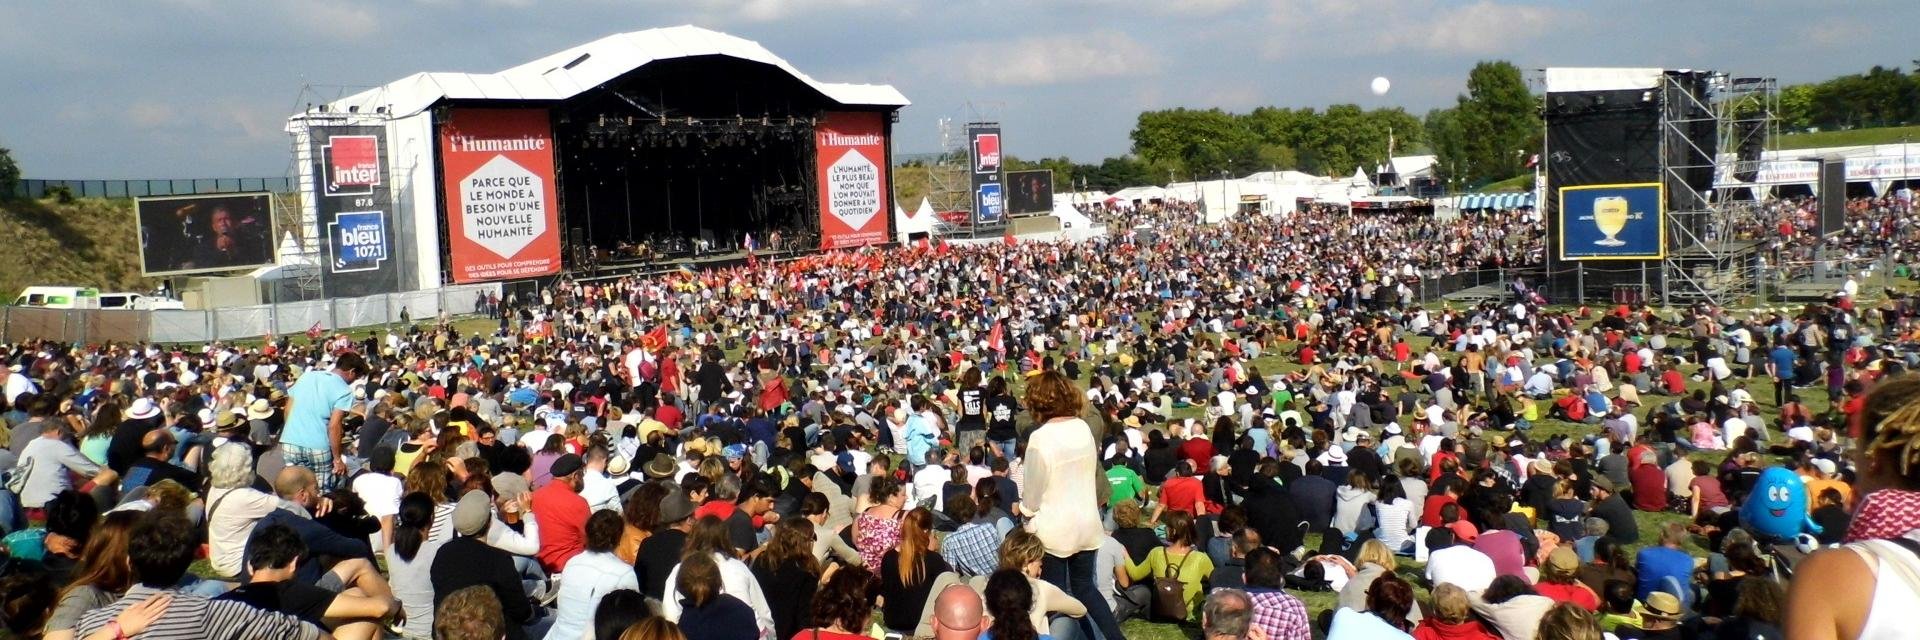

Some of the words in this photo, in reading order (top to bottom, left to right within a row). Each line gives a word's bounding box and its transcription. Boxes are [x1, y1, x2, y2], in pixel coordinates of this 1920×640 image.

[335, 165, 376, 184] inter
[832, 174, 841, 182] LE
[842, 173, 857, 182] PLUS
[858, 173, 875, 181] BEAU
[472, 178, 505, 188] PARCE
[508, 177, 530, 187] QUE
[840, 182, 855, 190] NOM
[856, 182, 869, 190] QUE
[470, 191, 482, 201] LE
[486, 189, 525, 200] MONDE
[528, 189, 535, 198] A
[833, 191, 849, 199] L'ON
[849, 190, 876, 198] POUVAIT
[982, 193, 1000, 206] bleu
[466, 203, 506, 214] BESOIN
[509, 201, 540, 212] D'UNE
[833, 199, 861, 208] DONNER
[868, 198, 876, 206] UN
[838, 207, 873, 217] QUOTIDIEN
[477, 214, 532, 226] NOUVELLE
[342, 228, 380, 246] bleu
[478, 226, 533, 239] HUMANITÉ
[354, 245, 382, 258] 107.1
